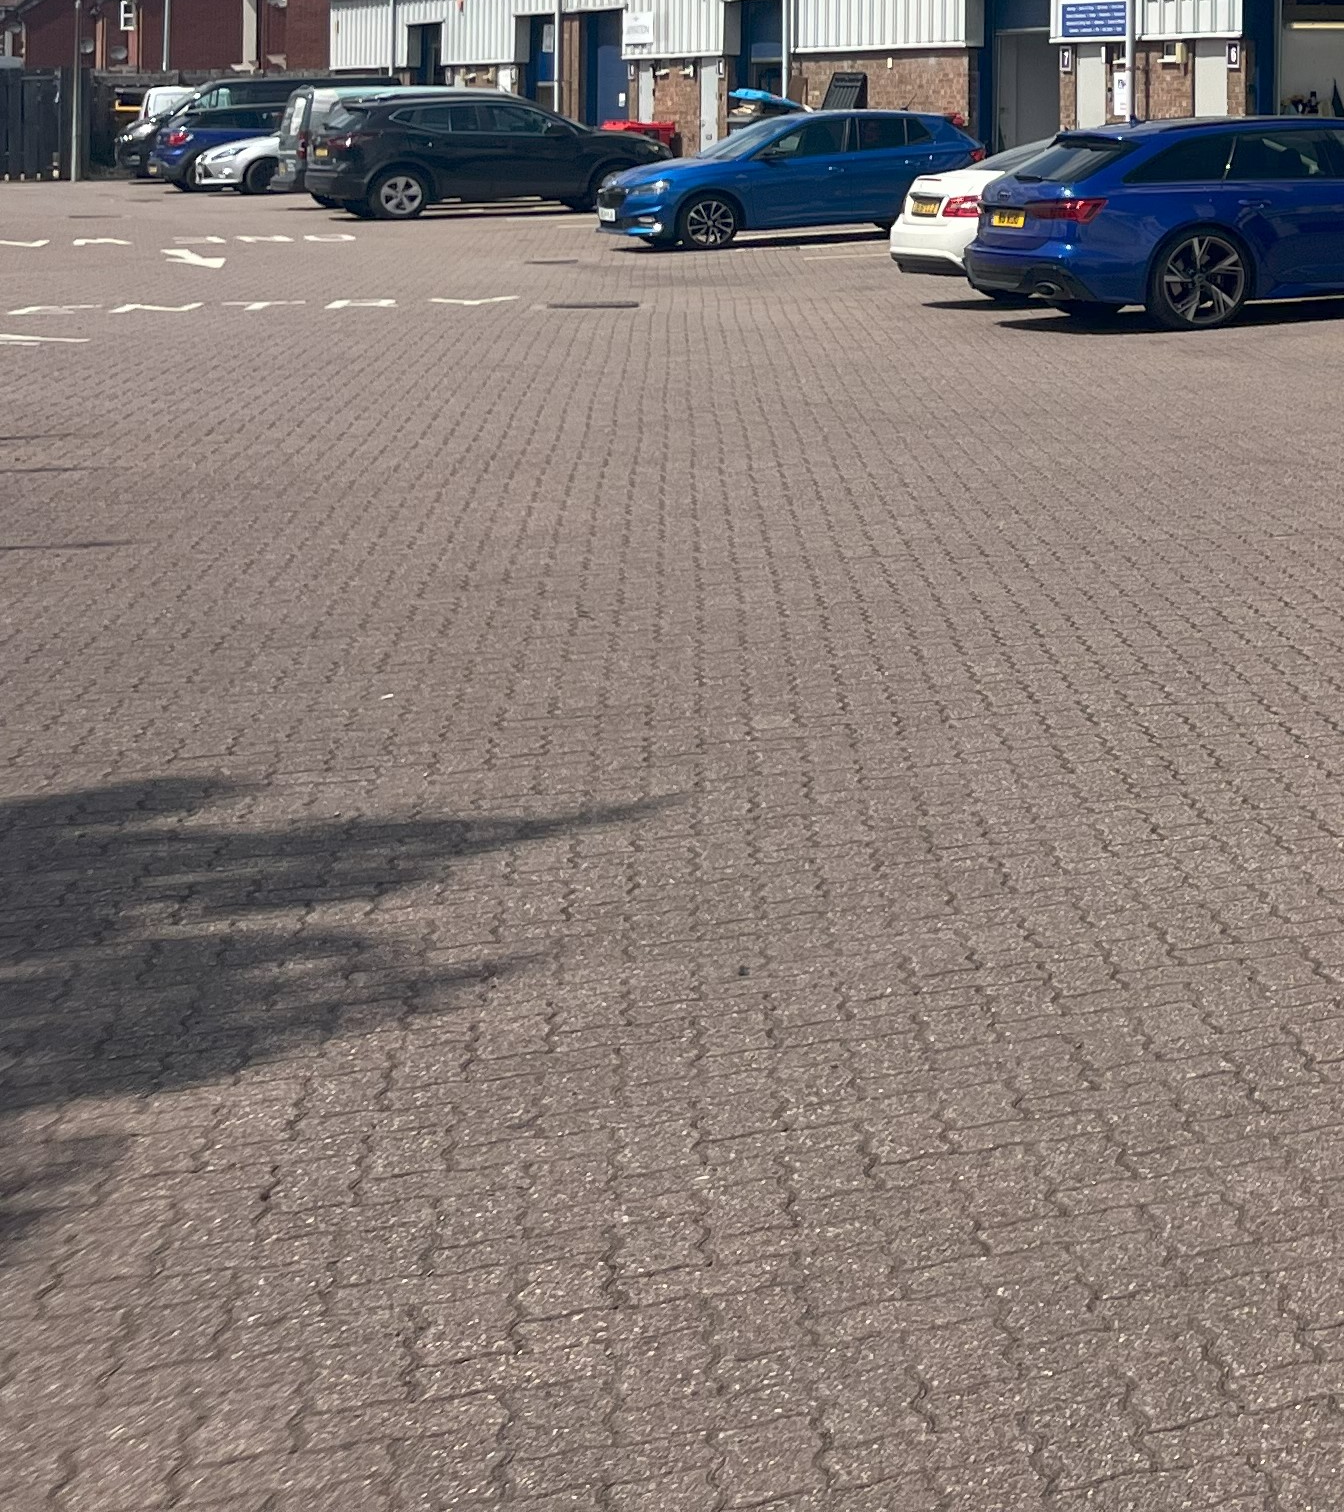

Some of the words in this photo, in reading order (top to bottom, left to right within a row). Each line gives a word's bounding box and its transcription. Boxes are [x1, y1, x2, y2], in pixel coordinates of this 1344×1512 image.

[1063, 50, 1069, 64] 7
[1230, 48, 1237, 63] 6
[7, 295, 520, 315] ENTRY
